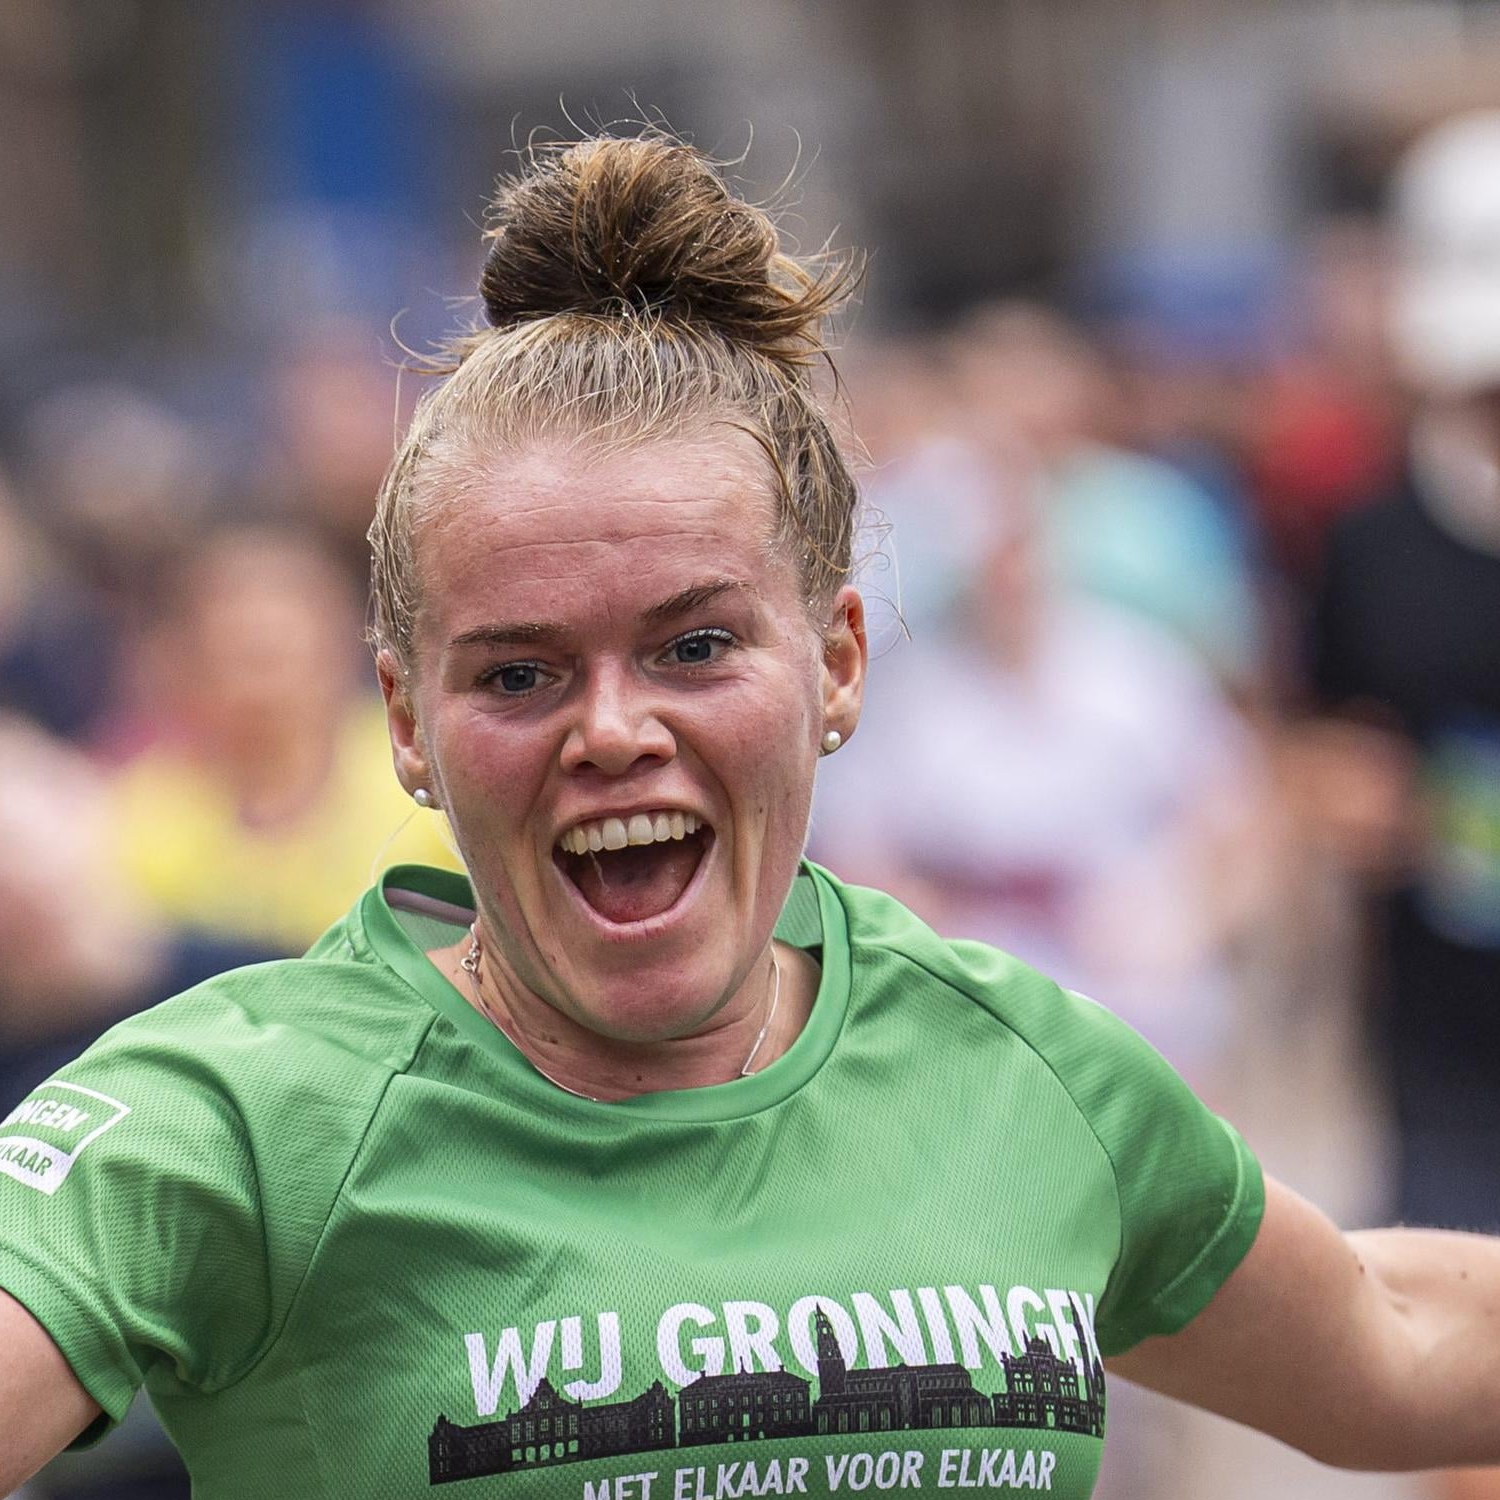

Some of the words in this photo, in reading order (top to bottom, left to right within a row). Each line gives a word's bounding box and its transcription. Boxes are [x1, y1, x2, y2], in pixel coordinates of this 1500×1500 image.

[465, 1311, 622, 1415] WIJ
[657, 1284, 1105, 1388] GRONINGEN
[825, 1450, 922, 1493] VOOR
[937, 1448, 1057, 1492] ELKAAR
